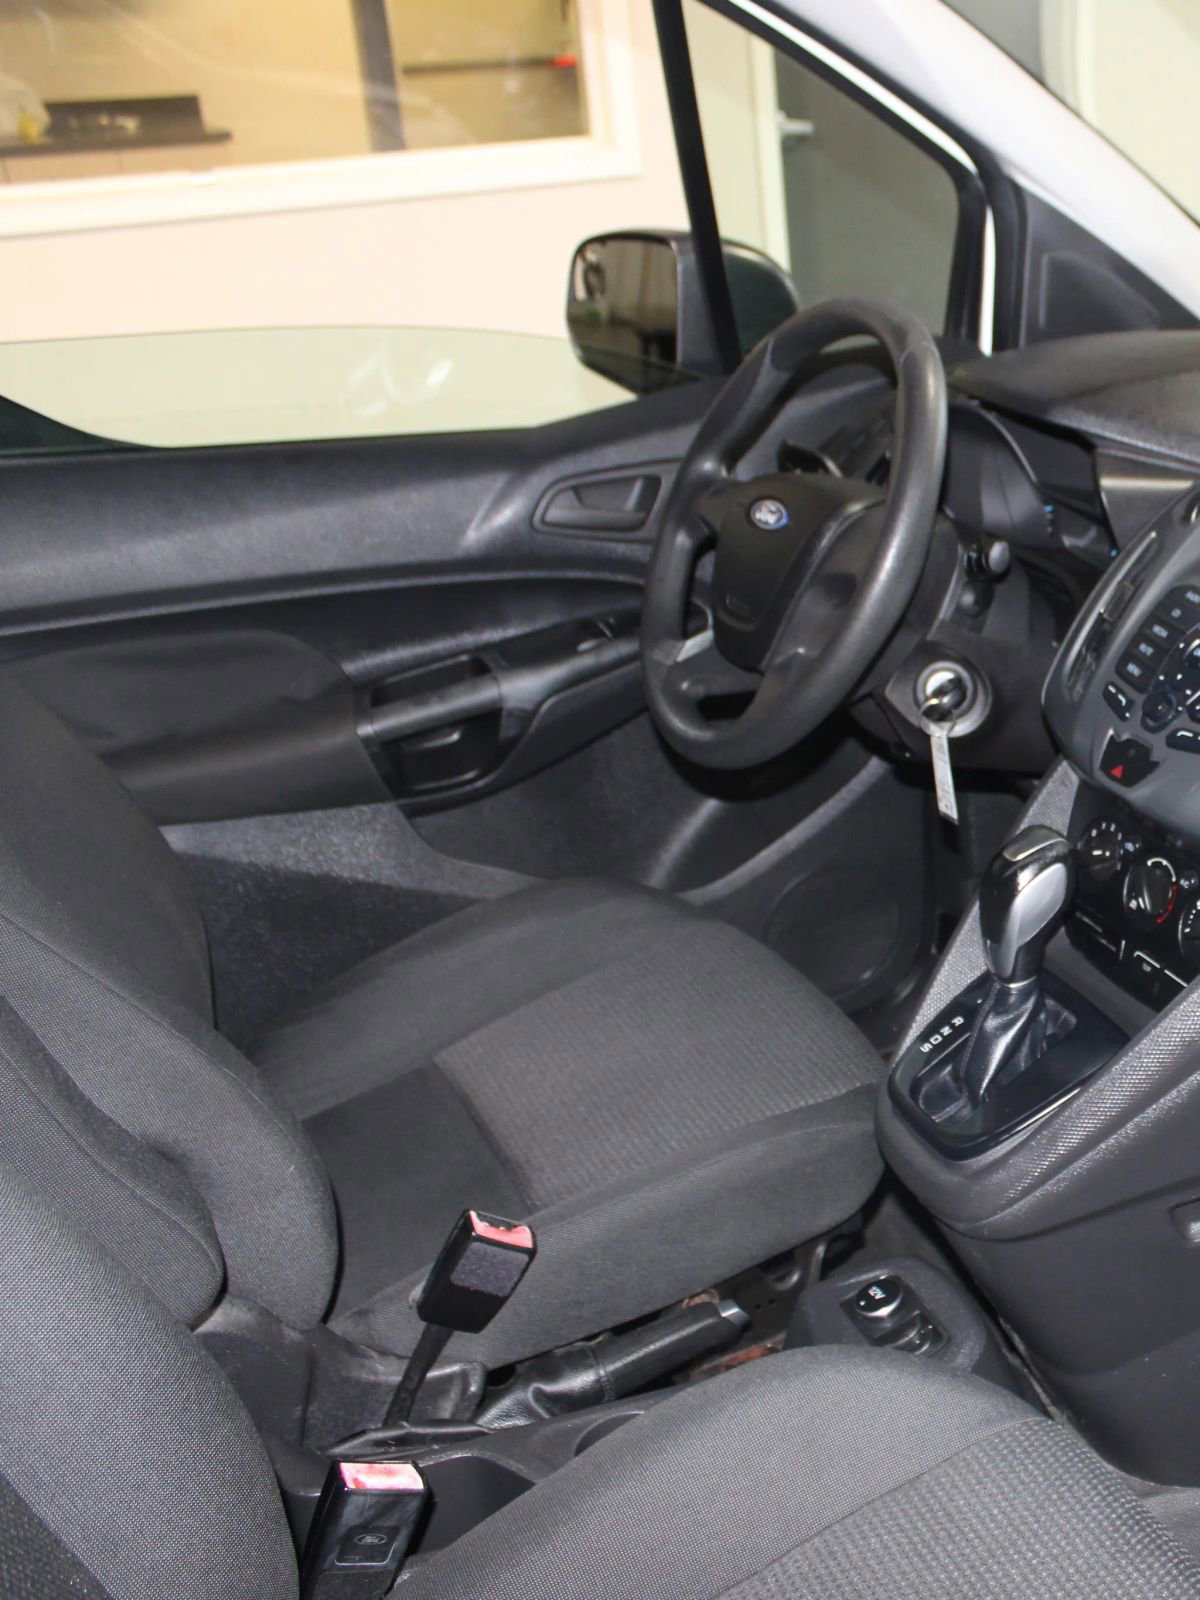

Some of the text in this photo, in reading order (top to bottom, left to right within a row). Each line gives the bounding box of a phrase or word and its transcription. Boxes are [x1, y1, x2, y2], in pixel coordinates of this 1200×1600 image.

[929, 1034, 943, 1045] D
[920, 1041, 934, 1053] S
[868, 1286, 886, 1300] 12V
